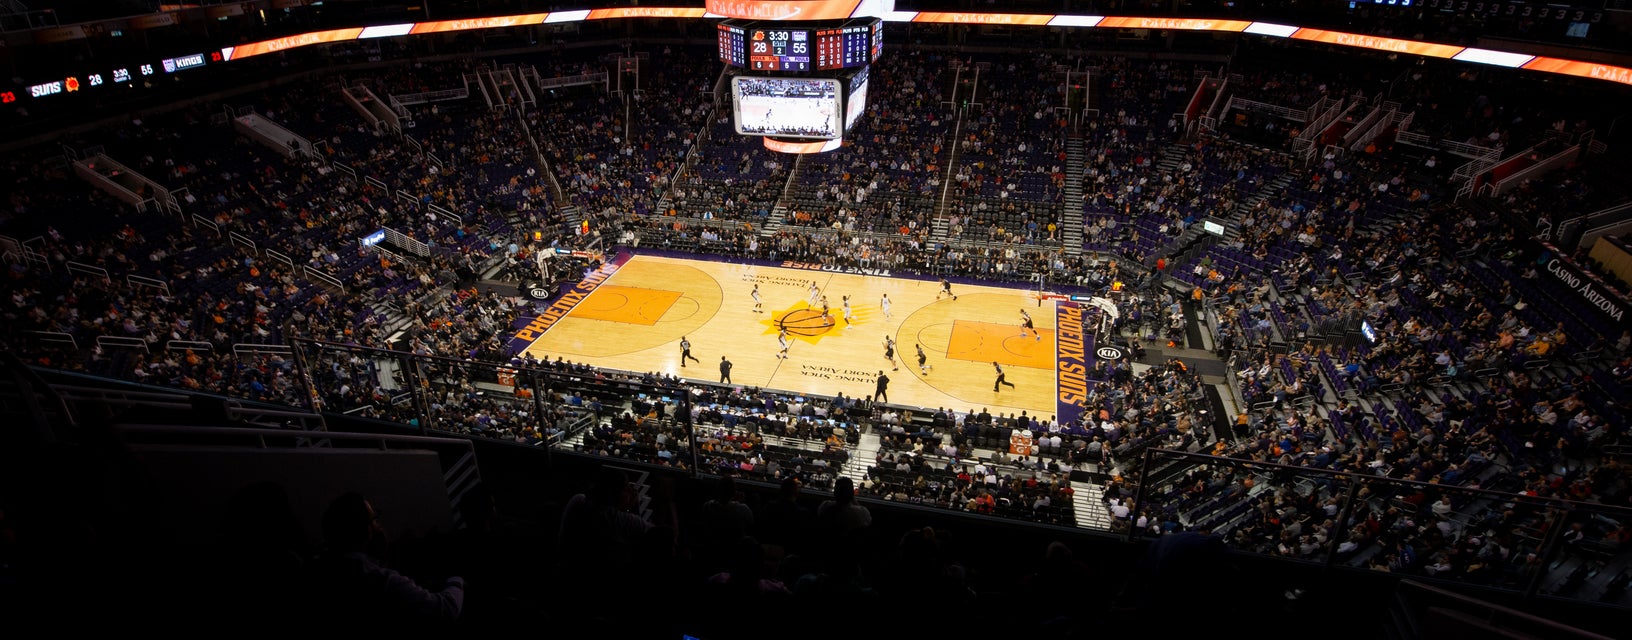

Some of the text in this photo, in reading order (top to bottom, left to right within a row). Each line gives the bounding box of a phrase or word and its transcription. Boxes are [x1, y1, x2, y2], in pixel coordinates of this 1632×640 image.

[769, 32, 788, 40] 3:30
[754, 42, 766, 52] 28
[793, 43, 806, 53] 55
[176, 55, 203, 68] KINGS
[113, 68, 128, 77] 3:30
[140, 64, 153, 75] 55
[89, 75, 102, 85] 28
[32, 81, 62, 97] SUNS
[1, 92, 16, 103] 23
[781, 260, 891, 276] TIME TO RISE
[1547, 258, 1624, 322] CASINO ARIZONA
[515, 262, 620, 342] PHOENIX SUNS
[1059, 306, 1085, 362] PHOENIX
[802, 364, 840, 374] ARENA
[800, 371, 876, 383] ALKING STICK
[1059, 362, 1087, 407] SUNS
